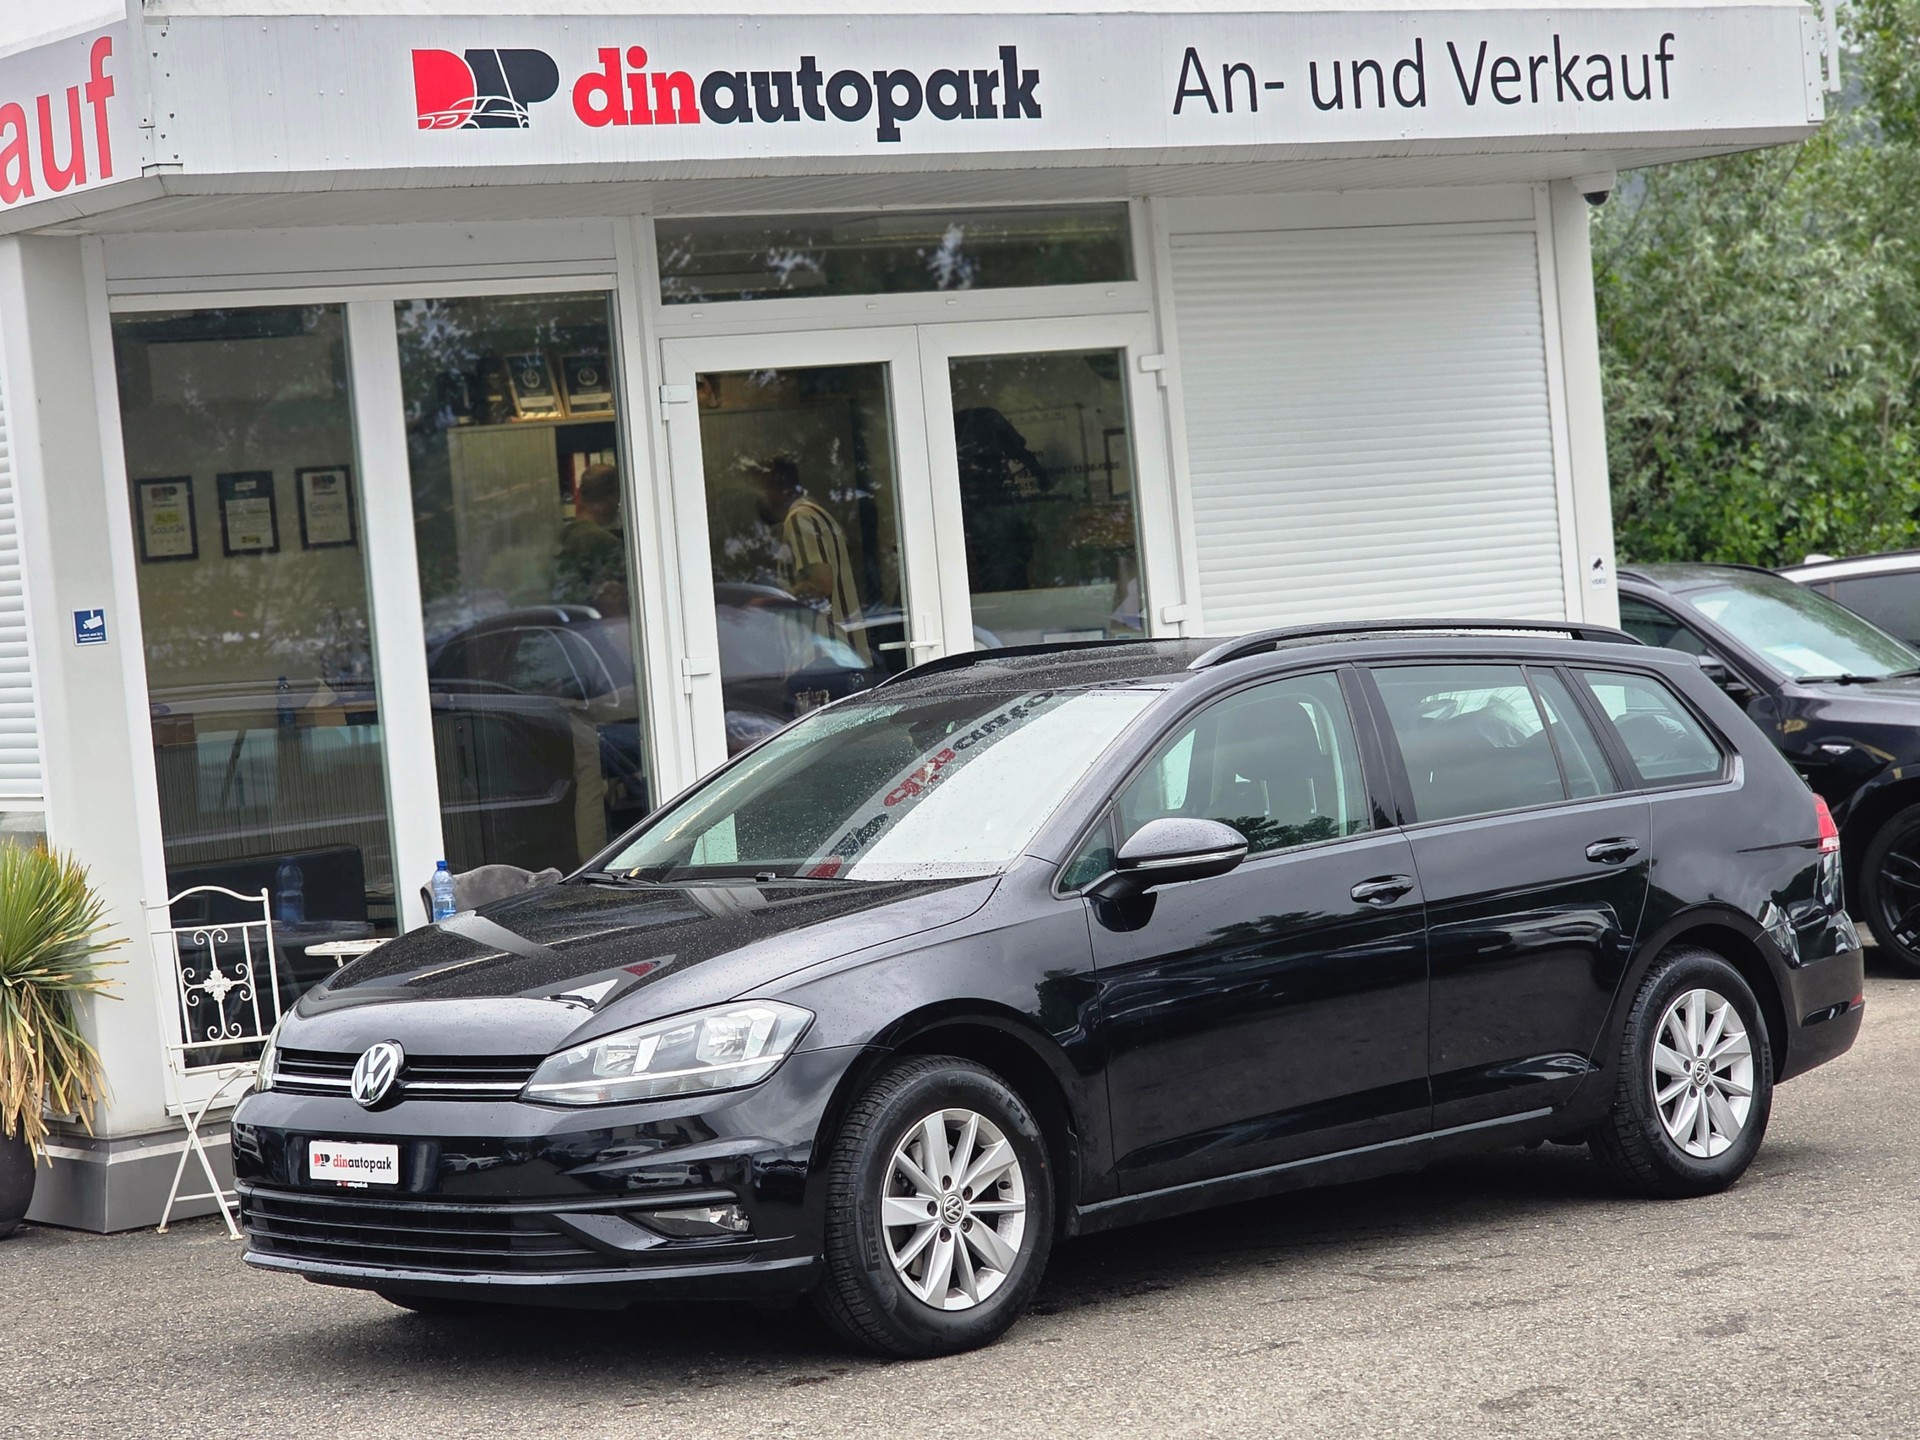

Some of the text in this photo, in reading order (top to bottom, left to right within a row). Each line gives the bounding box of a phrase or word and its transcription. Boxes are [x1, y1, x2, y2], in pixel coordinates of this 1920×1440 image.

[572, 45, 1041, 142] dinautopark
[1173, 33, 1675, 115] An- und Verkauf
[0, 36, 115, 204] auf
[333, 1154, 392, 1173] dinautopark
